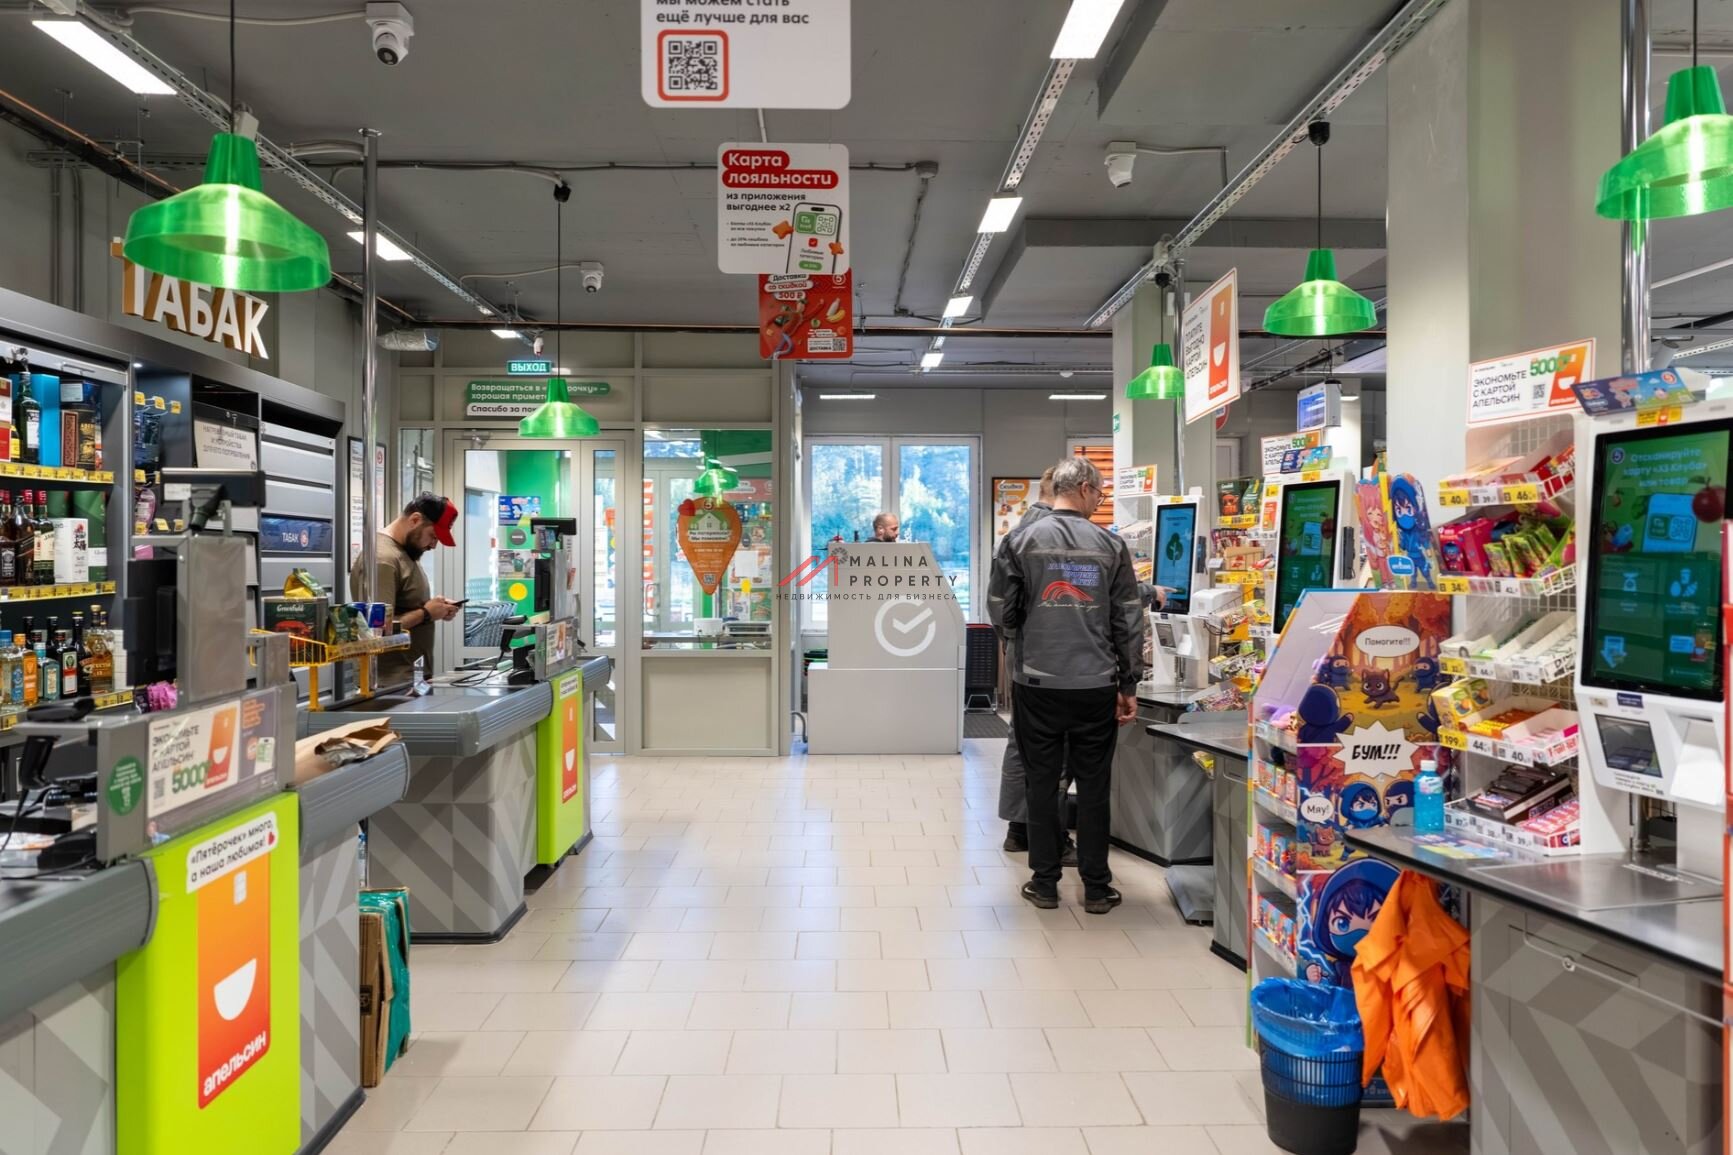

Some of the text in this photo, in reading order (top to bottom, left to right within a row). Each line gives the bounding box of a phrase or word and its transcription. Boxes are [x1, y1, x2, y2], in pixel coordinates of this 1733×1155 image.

[656, 10, 810, 26] ещё лучше для вас
[728, 152, 782, 169] Карта
[728, 172, 832, 185] лояльности
[740, 193, 806, 202] приложения
[726, 204, 777, 212] выгоднее
[111, 237, 269, 360] ТАБАК
[511, 362, 547, 372] ВЫХОД
[1473, 370, 1527, 388] ЭКОНОМЬТЕ
[472, 384, 534, 392] Возвращаться
[1481, 380, 1516, 396] КАРТОЙ
[1472, 394, 1520, 408] АПЕЛЬСИН
[282, 532, 299, 543] ТАБАК
[1364, 638, 1411, 646] Помогите!!!
[1352, 744, 1401, 760] БУМ!!!
[1512, 752, 1524, 762] 40
[1306, 801, 1330, 814] Мяу!
[191, 872, 197, 882] а
[200, 858, 224, 878] наша
[203, 1030, 267, 1097] апельсин
